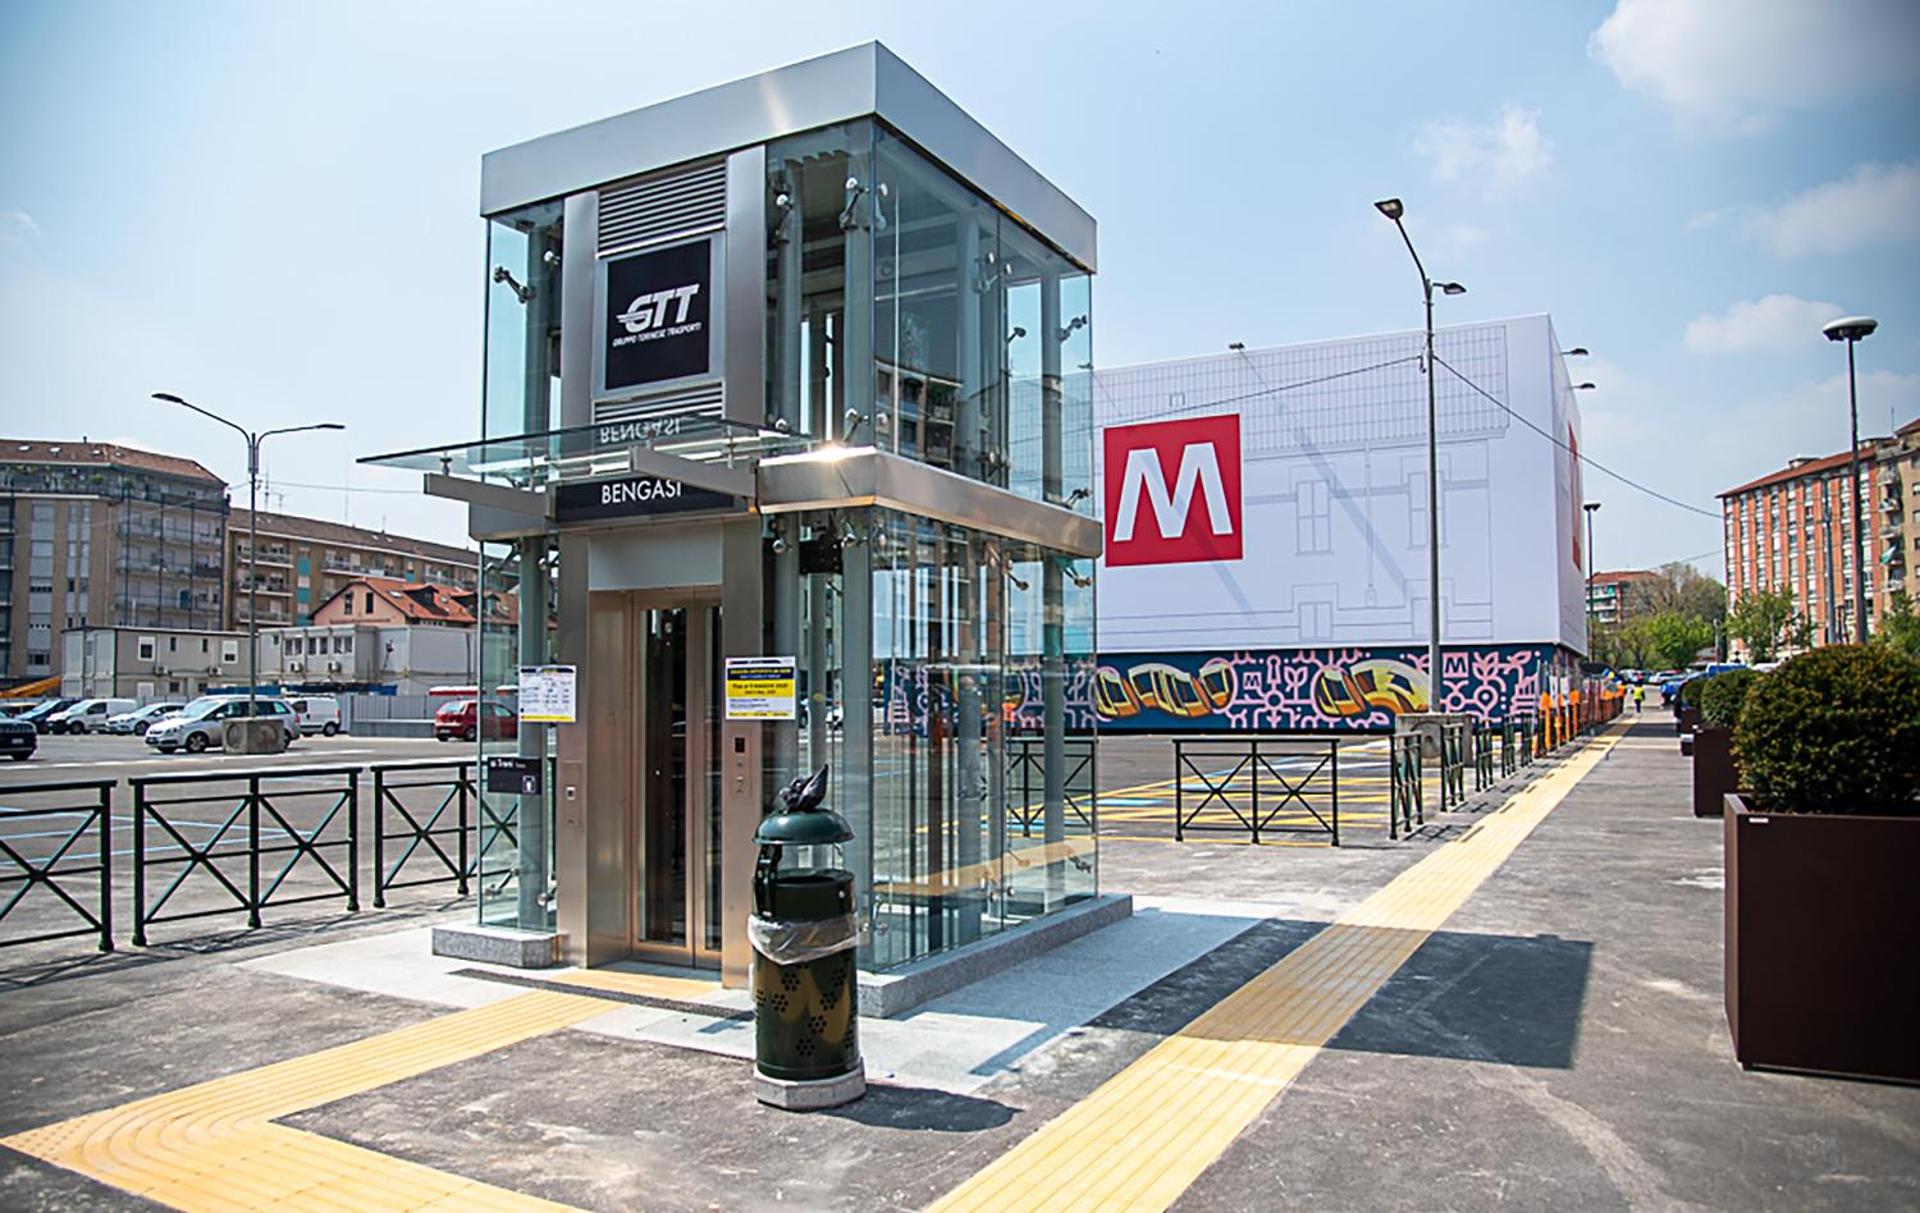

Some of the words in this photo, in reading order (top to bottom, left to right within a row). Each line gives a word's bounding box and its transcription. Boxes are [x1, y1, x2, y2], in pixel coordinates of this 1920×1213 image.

[616, 284, 700, 333] GTT
[601, 479, 682, 504] BENGASI
[1113, 441, 1234, 543] M
